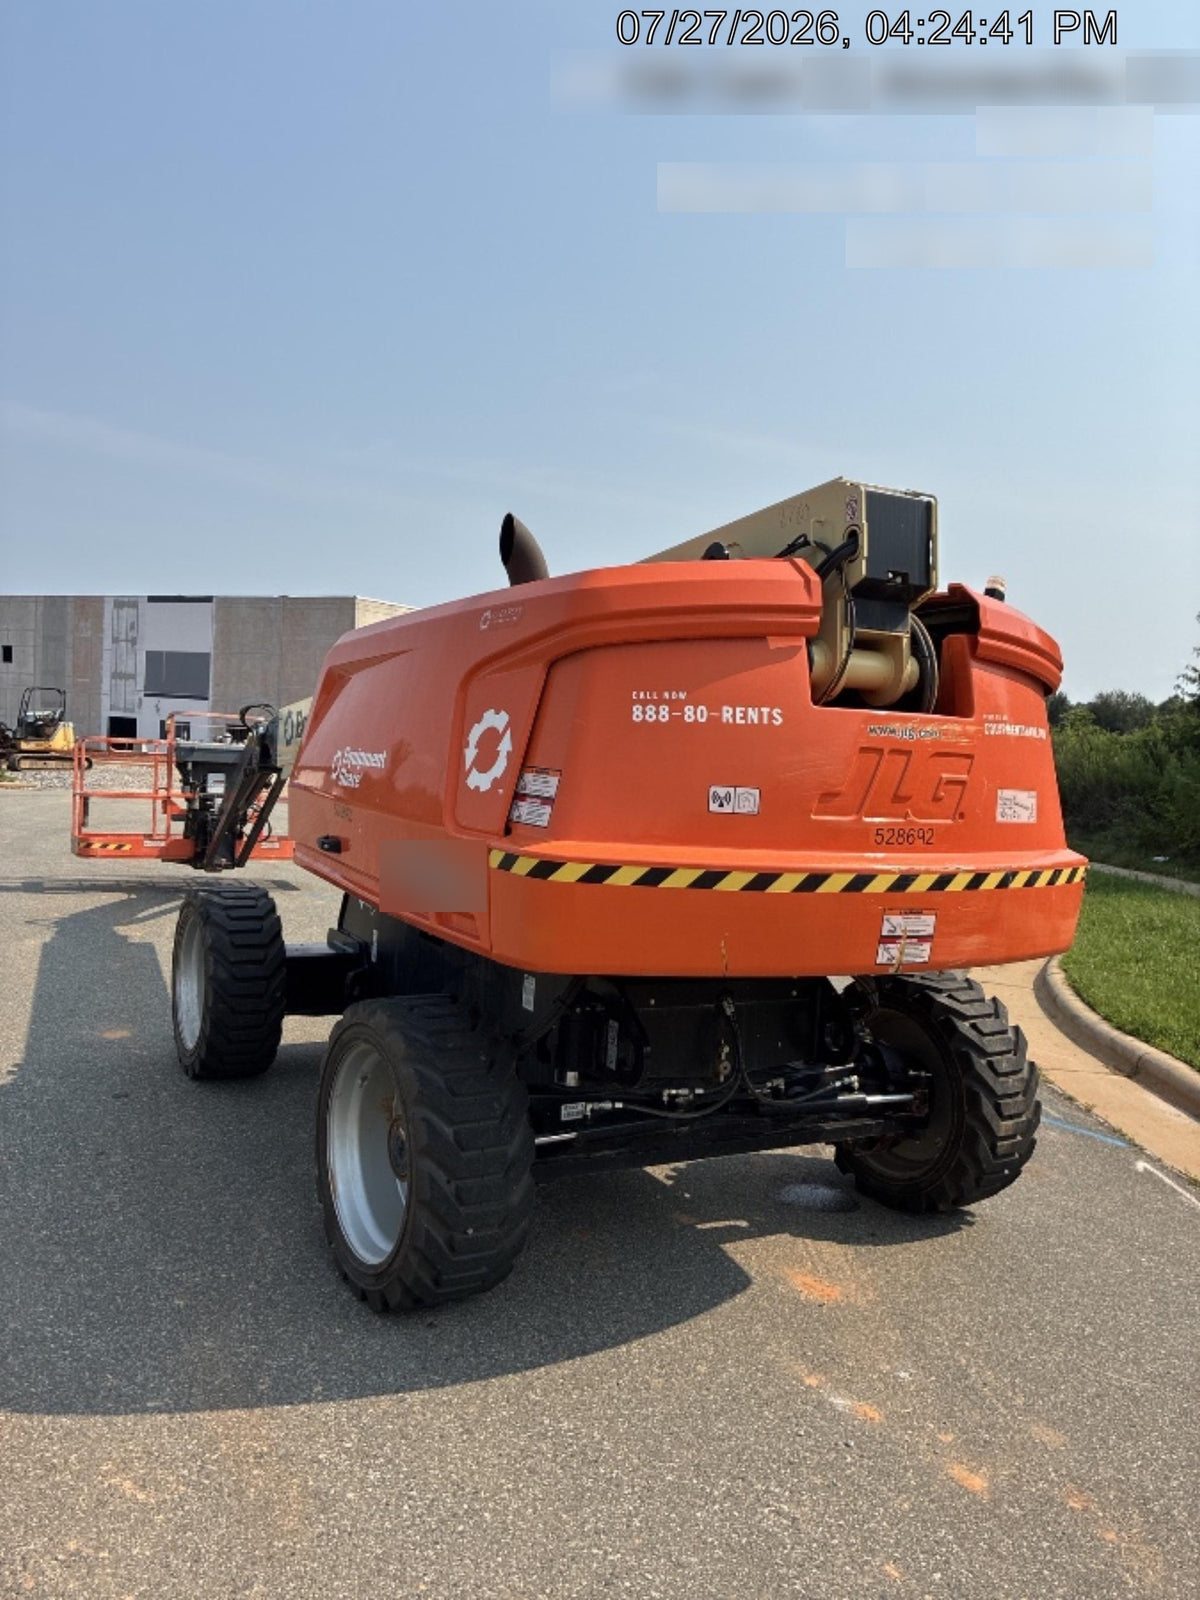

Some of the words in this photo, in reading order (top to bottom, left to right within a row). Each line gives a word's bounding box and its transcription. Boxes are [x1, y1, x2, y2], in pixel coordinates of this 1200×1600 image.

[632, 691, 658, 700] CALL
[663, 691, 687, 700] NOW
[632, 704, 784, 726] 888-80-RENTS
[811, 746, 975, 824] JLG
[874, 828, 935, 846] 528692
